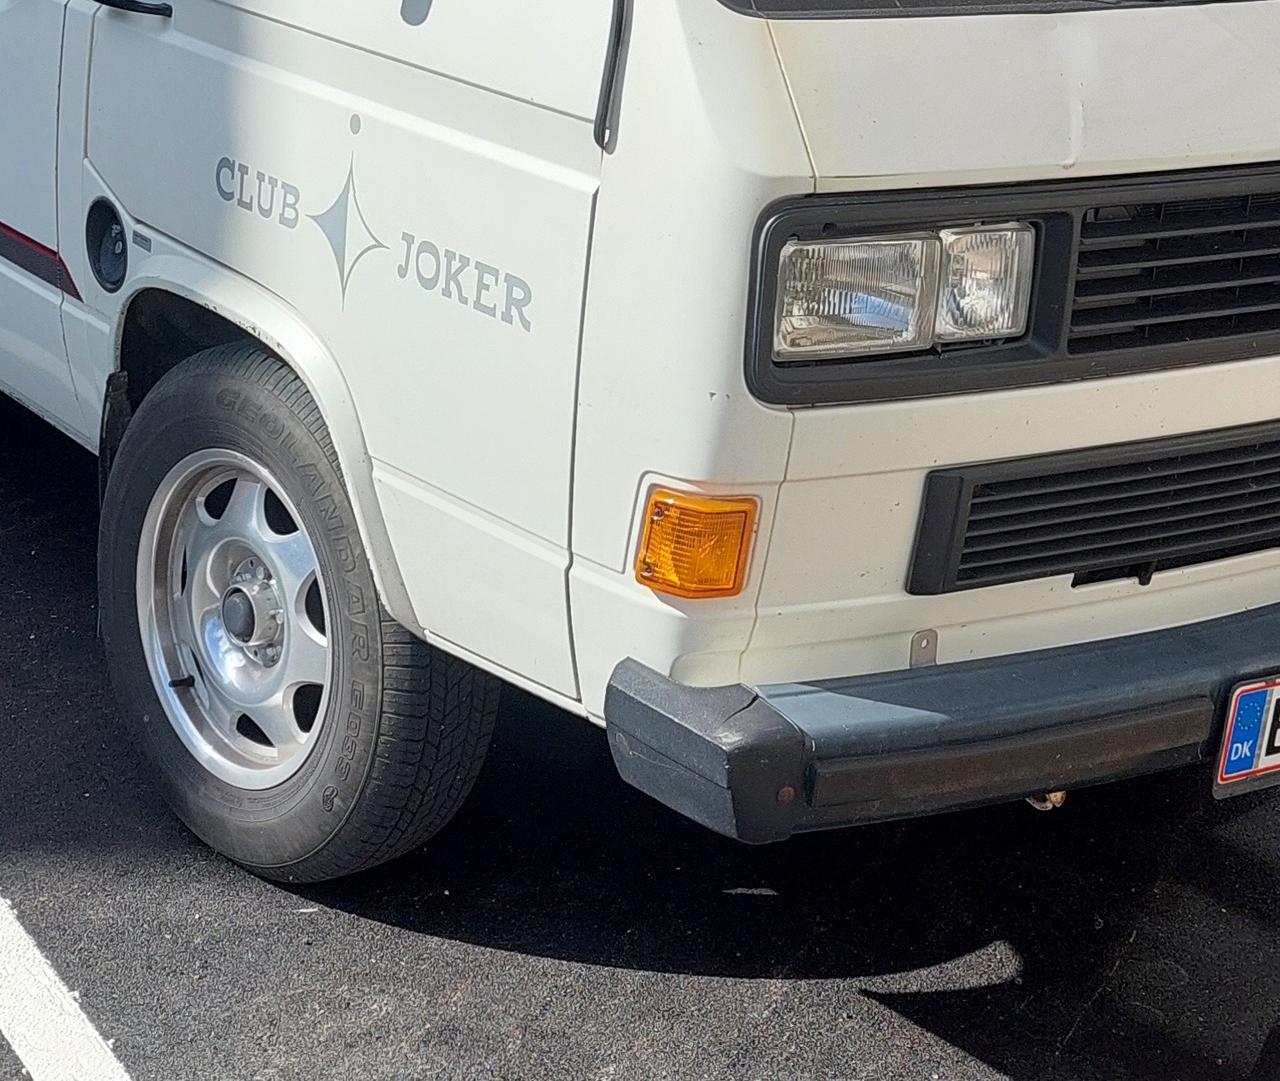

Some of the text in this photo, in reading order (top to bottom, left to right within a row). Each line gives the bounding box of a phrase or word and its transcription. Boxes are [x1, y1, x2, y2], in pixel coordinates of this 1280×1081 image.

[215, 155, 533, 333] CLUB JOKER
[216, 387, 370, 663] GEOLANDAR
[1230, 738, 1252, 761] DK
